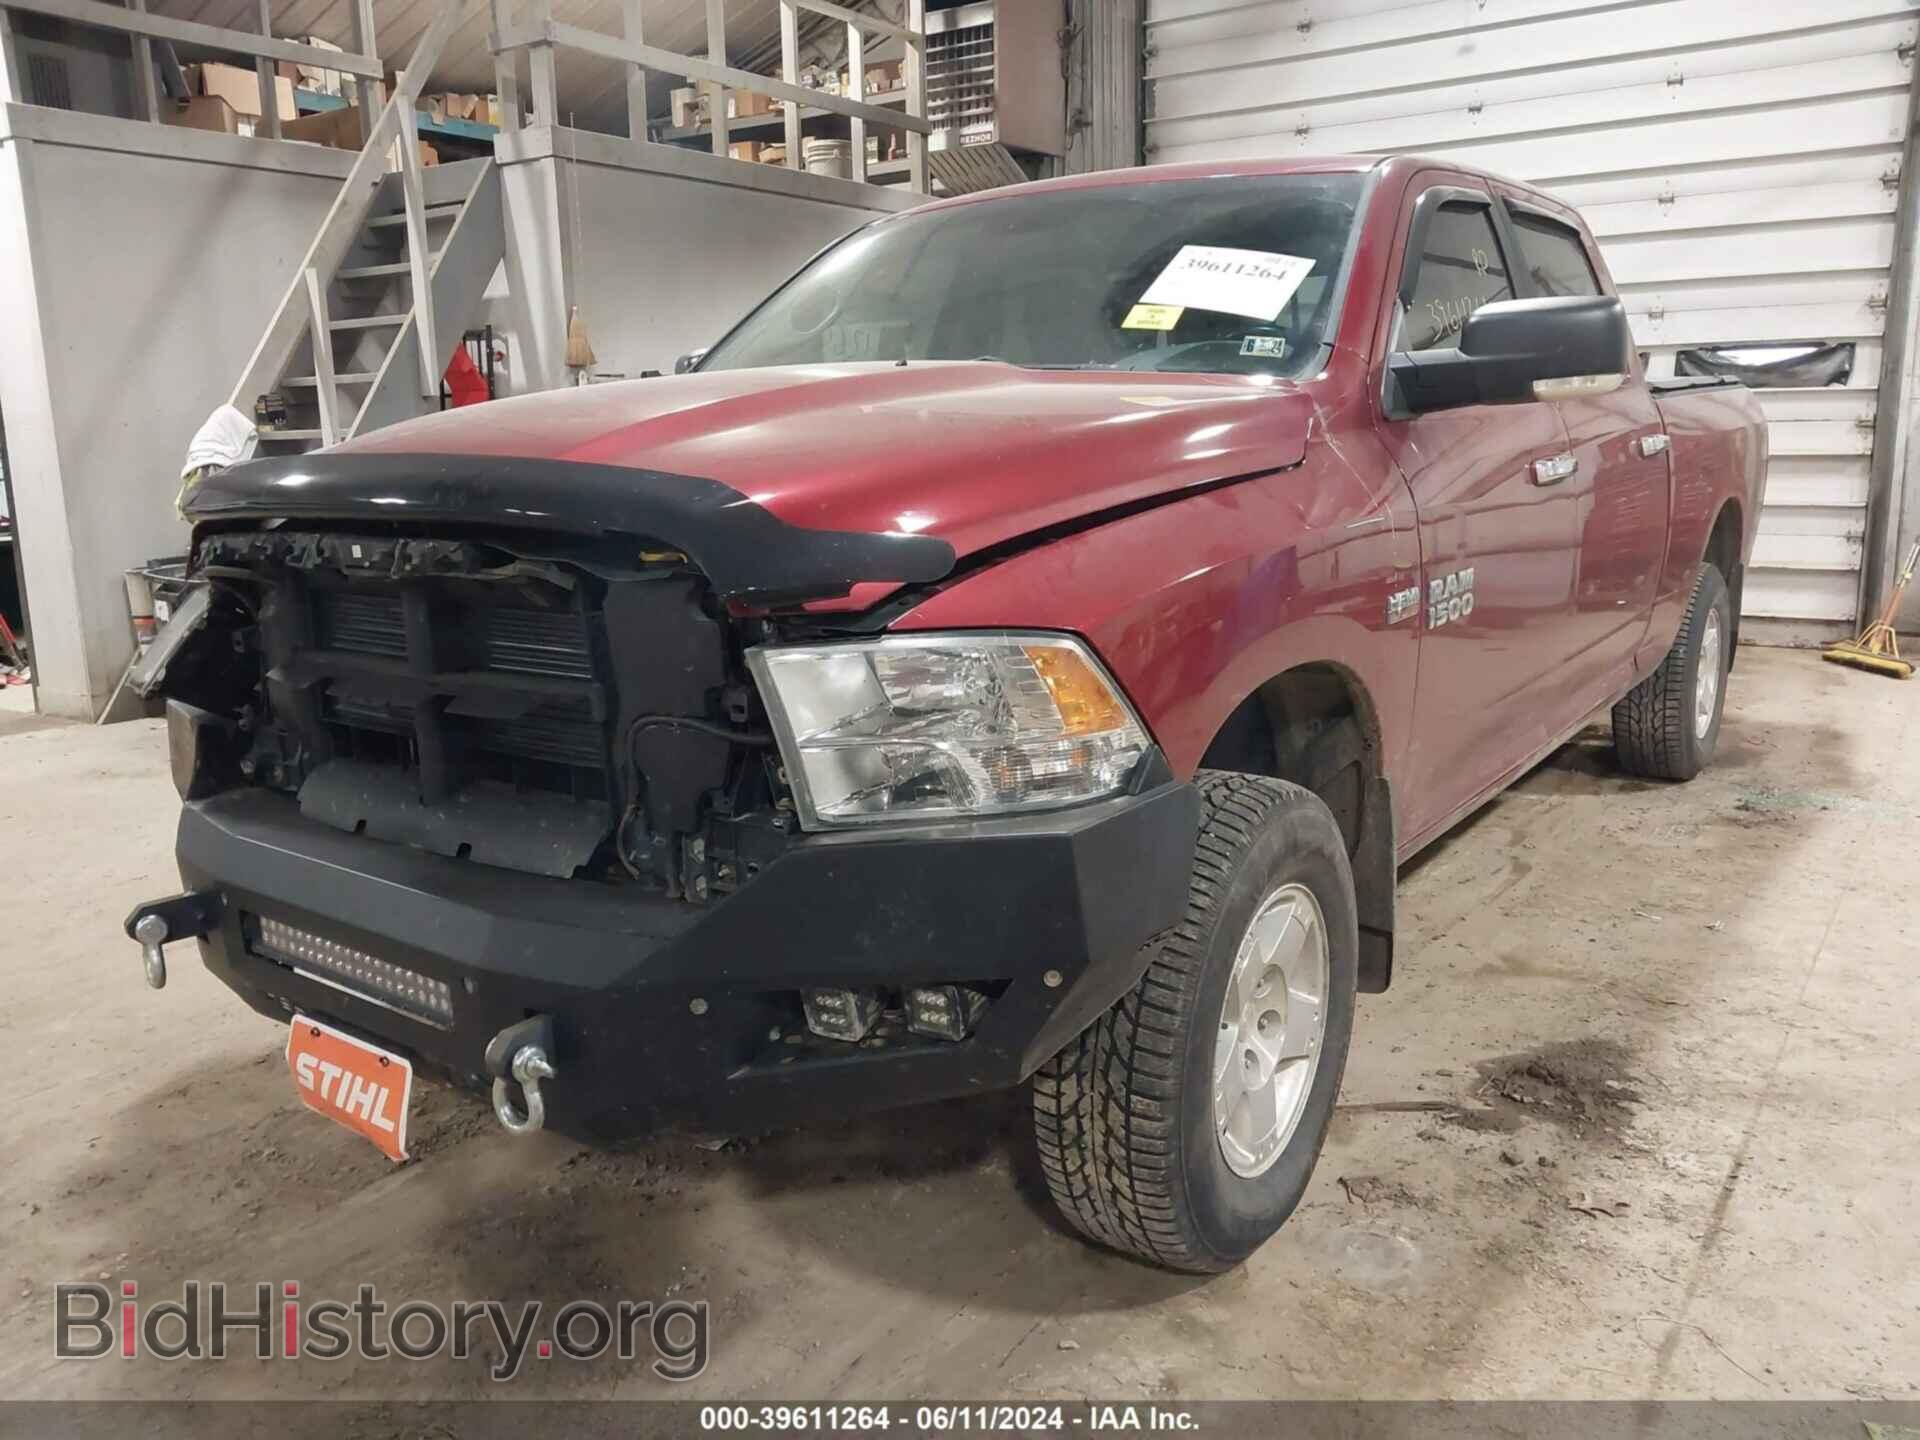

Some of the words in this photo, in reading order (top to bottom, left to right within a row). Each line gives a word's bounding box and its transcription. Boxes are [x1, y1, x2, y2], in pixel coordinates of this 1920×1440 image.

[1181, 258, 1288, 280] 39611264
[1430, 568, 1474, 603] RAM
[1428, 592, 1474, 629] 1500
[296, 1052, 395, 1132] STIHL
